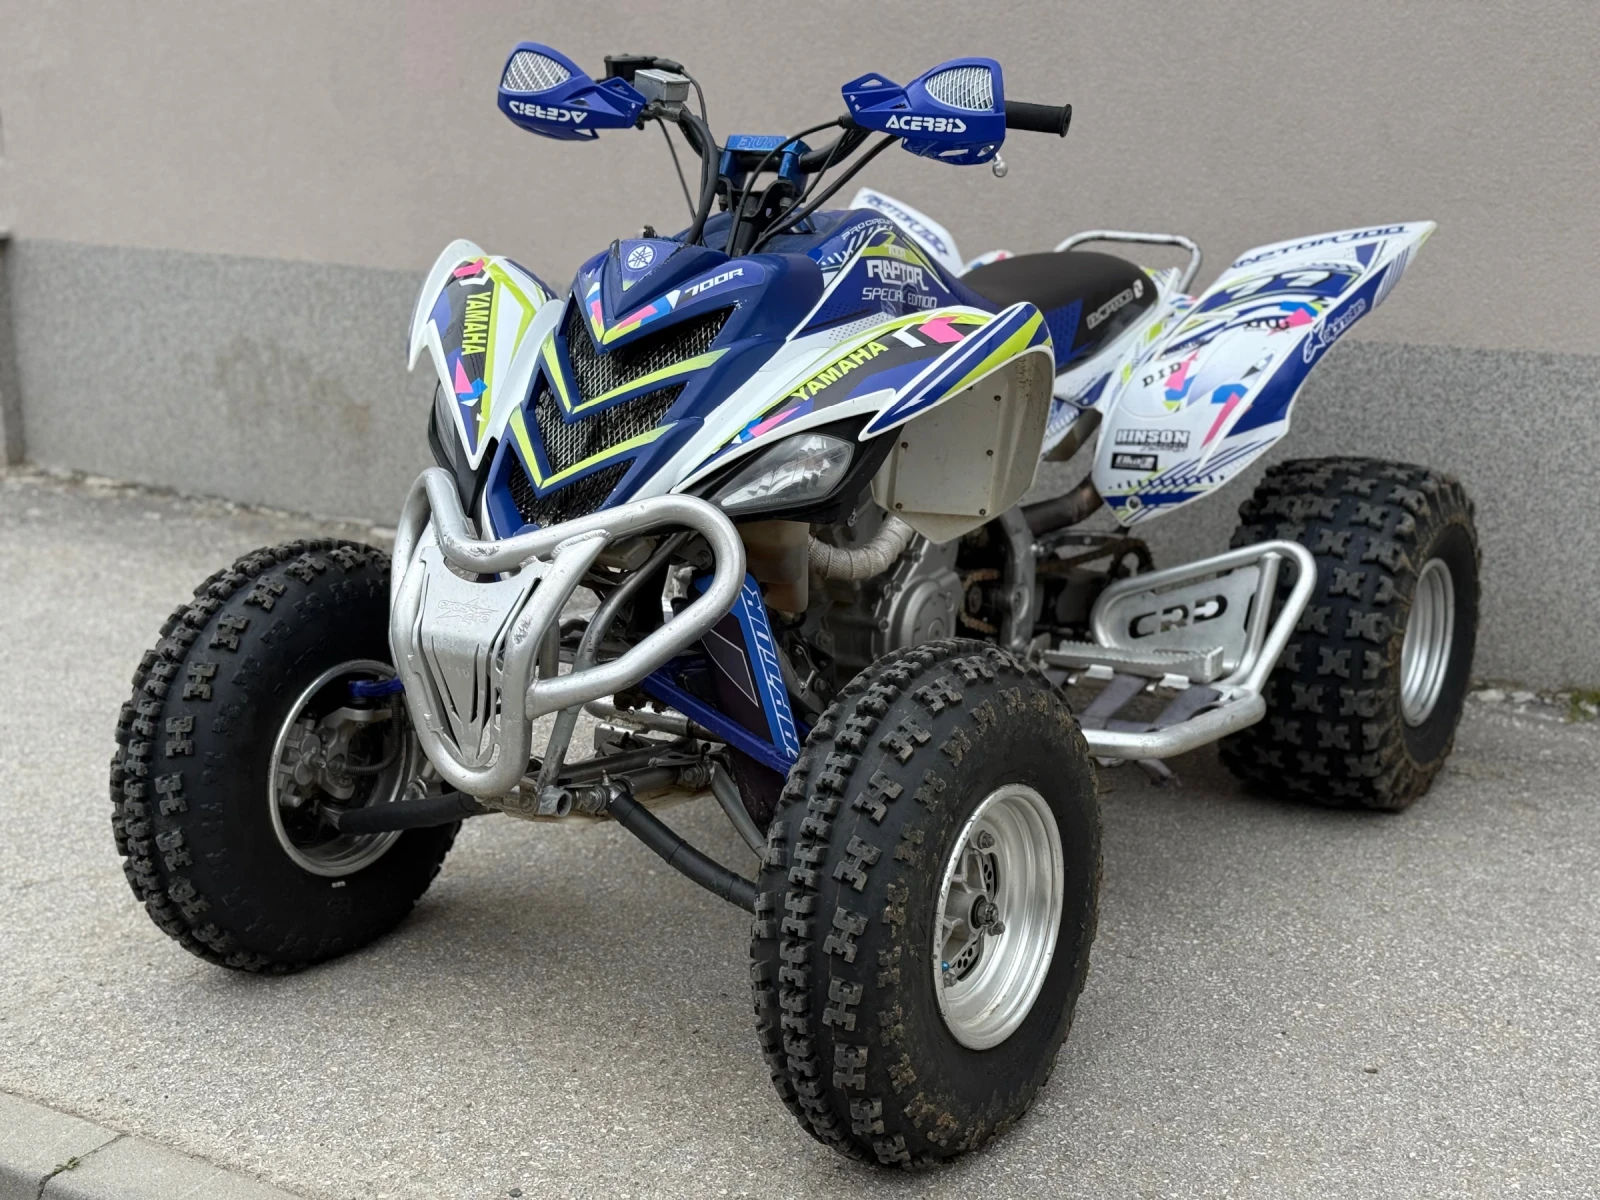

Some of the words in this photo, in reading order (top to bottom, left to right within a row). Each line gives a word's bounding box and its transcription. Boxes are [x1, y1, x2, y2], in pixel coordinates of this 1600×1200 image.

[509, 100, 588, 124] ACERBIS
[885, 114, 967, 133] ACERBIS
[684, 267, 744, 297] 700R
[866, 259, 929, 291] RAPTOR
[861, 287, 906, 304] SPECIAL
[907, 296, 938, 309] EDITION
[461, 291, 492, 356] YAMAHA
[790, 341, 889, 401] YAMAHA
[1115, 430, 1190, 446] HINSON
[1128, 594, 1229, 639] CRD
